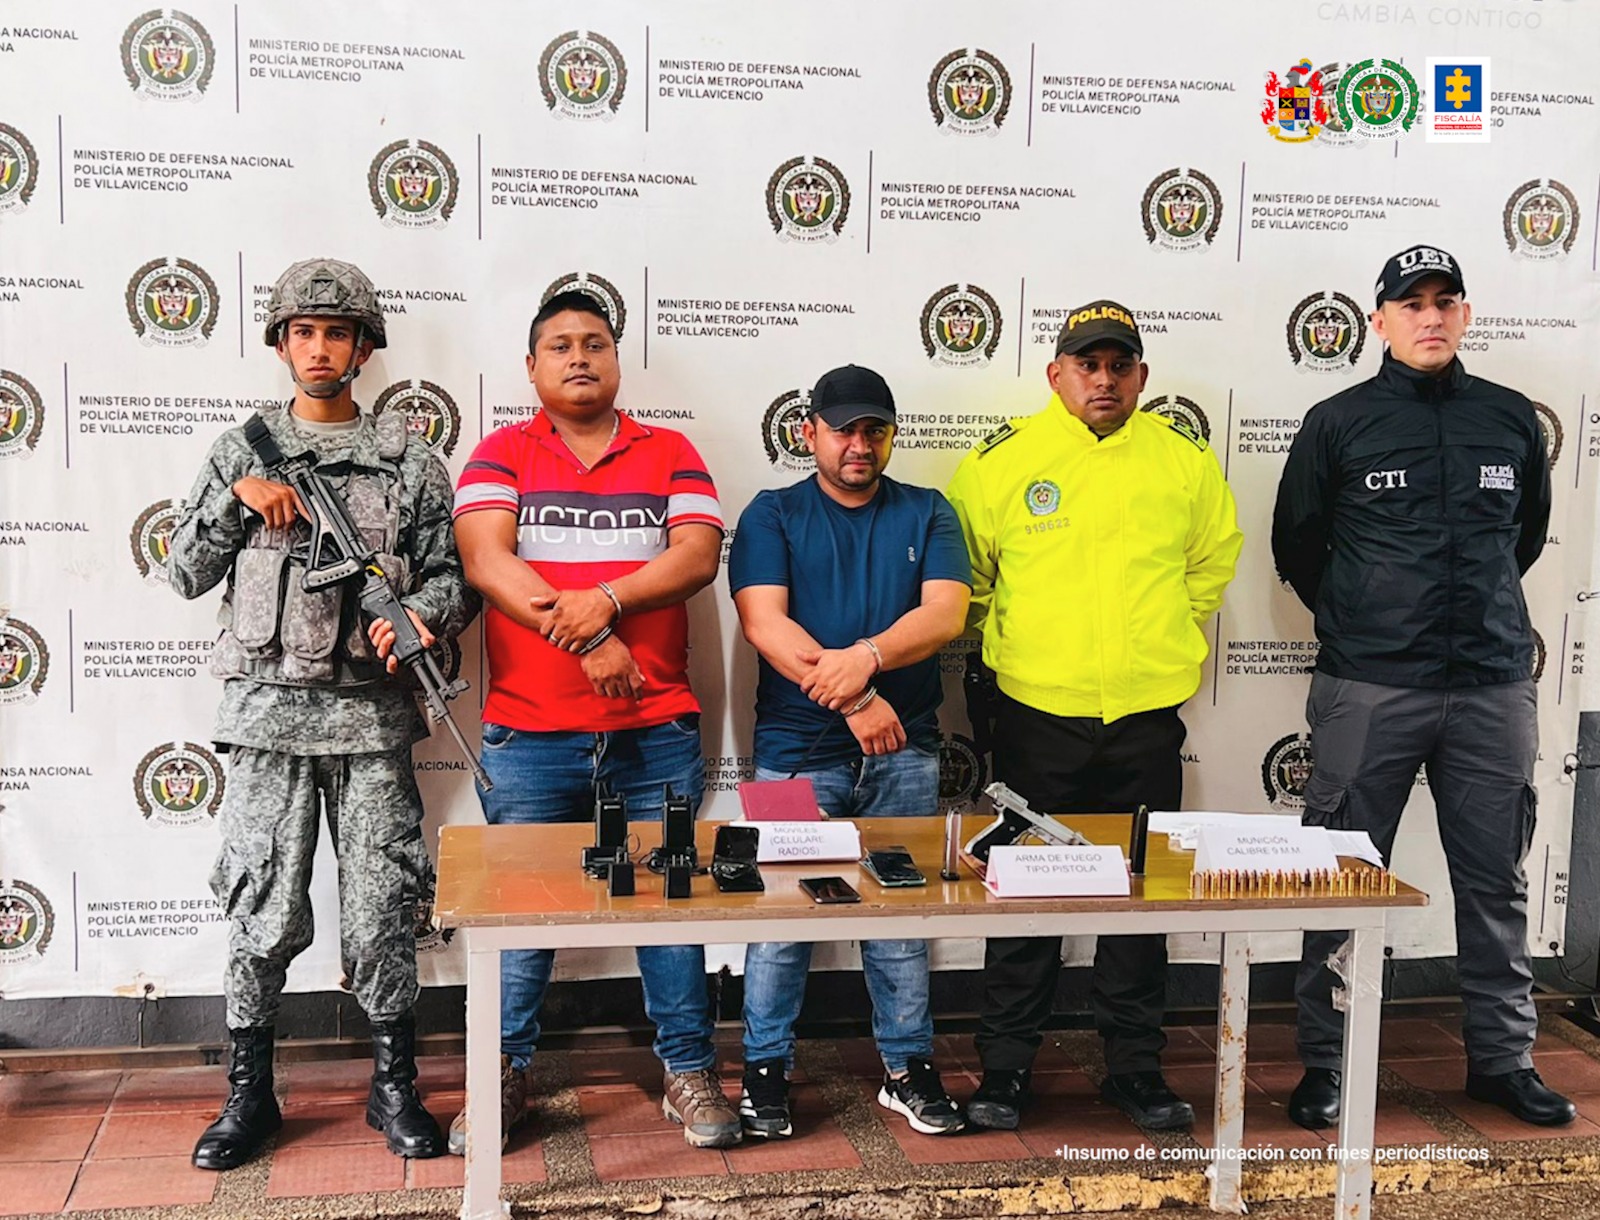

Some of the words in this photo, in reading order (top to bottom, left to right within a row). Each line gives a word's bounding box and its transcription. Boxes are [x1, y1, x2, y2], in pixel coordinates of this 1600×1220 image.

[13, 28, 78, 40] NACIONAL
[249, 39, 320, 52] MINISTERIO
[323, 43, 340, 53] DE
[343, 43, 400, 56] DEFENSA
[403, 47, 465, 59] NACIONAL
[250, 54, 298, 65] POLICÍA
[301, 56, 404, 71] METROPOLITANA
[659, 60, 725, 72] MINISTERIO
[729, 62, 743, 72] DE
[746, 63, 800, 75] DEFENSA
[803, 66, 861, 77] NACIONAL
[250, 67, 266, 77] DE
[270, 68, 361, 82] VILLAVICENCIO
[659, 73, 704, 85] POLICÍA
[707, 76, 804, 89] METROPOLITANA
[1042, 76, 1105, 87] MINISTERIO
[1109, 78, 1122, 88] DE
[1126, 79, 1177, 90] DEFENSA
[1180, 81, 1236, 91] NACIONAL
[659, 88, 674, 97] DE
[677, 88, 763, 101] VILLAVICENCIO
[1042, 90, 1085, 101] POLICÍA
[1088, 92, 1180, 103] METROPOLITANA
[1491, 92, 1539, 102] DEFENSA
[1542, 93, 1594, 104] NACIONAL
[1042, 104, 1056, 113] DE
[1059, 104, 1141, 115] VILLAVICENCIO
[1491, 106, 1541, 116] POLITANA
[74, 150, 145, 162] MINISTERIO
[149, 152, 166, 163] DE
[170, 153, 227, 165] DEFENSA
[231, 156, 294, 168] NACIONAL
[74, 164, 123, 175] POLICÍA
[127, 167, 232, 180] METROPOLITANA
[491, 167, 559, 180] MINISTERIO
[562, 170, 578, 180] DE
[581, 171, 635, 183] DEFENSA
[638, 174, 697, 185] NACIONAL
[74, 178, 91, 188] DE
[94, 179, 188, 192] VILLAVICENCIO
[491, 182, 537, 193] POLICÍA
[541, 185, 639, 197] METROPOLITANA
[881, 183, 945, 194] MINISTERIO
[948, 186, 962, 195] DE
[966, 186, 1017, 196] DEFENSA
[1020, 188, 1076, 198] NACIONAL
[492, 195, 507, 205] DE
[510, 196, 598, 209] VILLAVICENCIO
[881, 196, 924, 208] POLICÍA
[927, 199, 1020, 210] METROPOLITANA
[1253, 193, 1314, 204] MINISTERIO
[1317, 195, 1331, 205] DE
[1334, 195, 1384, 206] DEFENSA
[1386, 197, 1440, 207] NACIONAL
[880, 211, 895, 220] DE
[898, 211, 981, 222] VILLAVICENCIO
[1252, 206, 1294, 218] POLICÍA
[1297, 209, 1386, 220] METROPOLITANA
[1252, 219, 1266, 229] DE
[1269, 220, 1349, 231] VILLAVICENCIO
[1397, 248, 1453, 269] UEI
[19, 278, 84, 289] NACIONAL
[405, 290, 467, 301] NACIONAL
[657, 299, 722, 310] MINISTERIO
[725, 301, 740, 311] DE
[743, 302, 795, 312] DEFENSA
[798, 303, 855, 314] NACIONAL
[657, 312, 701, 323] POLICÍA
[705, 314, 799, 326] METROPOLITANA
[1032, 309, 1069, 318] MINIST
[1068, 306, 1135, 330] POLICIA
[1168, 311, 1223, 321] NACIONAL
[1475, 317, 1524, 327] DEFENSA
[1526, 319, 1577, 328] NACIONAL
[657, 326, 672, 335] DE
[676, 327, 759, 337] VILLAVICENCIO
[79, 396, 151, 407] MINISTERIO
[154, 397, 171, 407] DE
[174, 398, 232, 408] DEFENSA
[236, 399, 288, 409] NACION
[80, 409, 129, 421] POLICÍA
[132, 412, 236, 423] METROPOLITANA
[493, 406, 538, 416] MINISTE
[637, 409, 695, 419] NACIONAL
[897, 414, 936, 424] STERIO
[939, 414, 954, 424] DE
[957, 415, 1006, 424] DEFENSA
[1240, 419, 1300, 428] MINISTERIO
[80, 423, 96, 433] DE
[99, 423, 193, 435] VILLAVICENCIO
[1239, 431, 1281, 441] POLICÍA
[1239, 444, 1253, 453] DE
[1365, 470, 1407, 490] CTI
[25, 521, 89, 532] NACIONAL
[84, 641, 154, 651] MINISTERIO
[158, 641, 174, 650] DE
[1228, 641, 1288, 650] MINISTERIO
[1291, 641, 1305, 650] DE
[84, 653, 131, 665] POLICÍA
[1227, 652, 1268, 663] POLICÍA
[85, 668, 101, 677] DE
[104, 668, 196, 677] VILLAVICENCIO
[1227, 666, 1240, 674] DE
[719, 757, 733, 767] DE
[29, 766, 93, 776] NACIONAL
[1015, 854, 1046, 862] ARMA
[1048, 854, 1062, 862] DE
[1065, 853, 1102, 862] FUEGO
[1227, 847, 1271, 856] CALIBRE
[1025, 865, 1050, 874] TIPO
[1053, 865, 1098, 873] PISTOLA
[88, 901, 157, 911] MINISTERIO
[161, 900, 176, 909] DE
[88, 913, 135, 925] POLICÍA
[139, 914, 232, 924] METROPOLITAN
[89, 928, 104, 937] DE
[108, 926, 198, 937] VILLAVICENCIO
